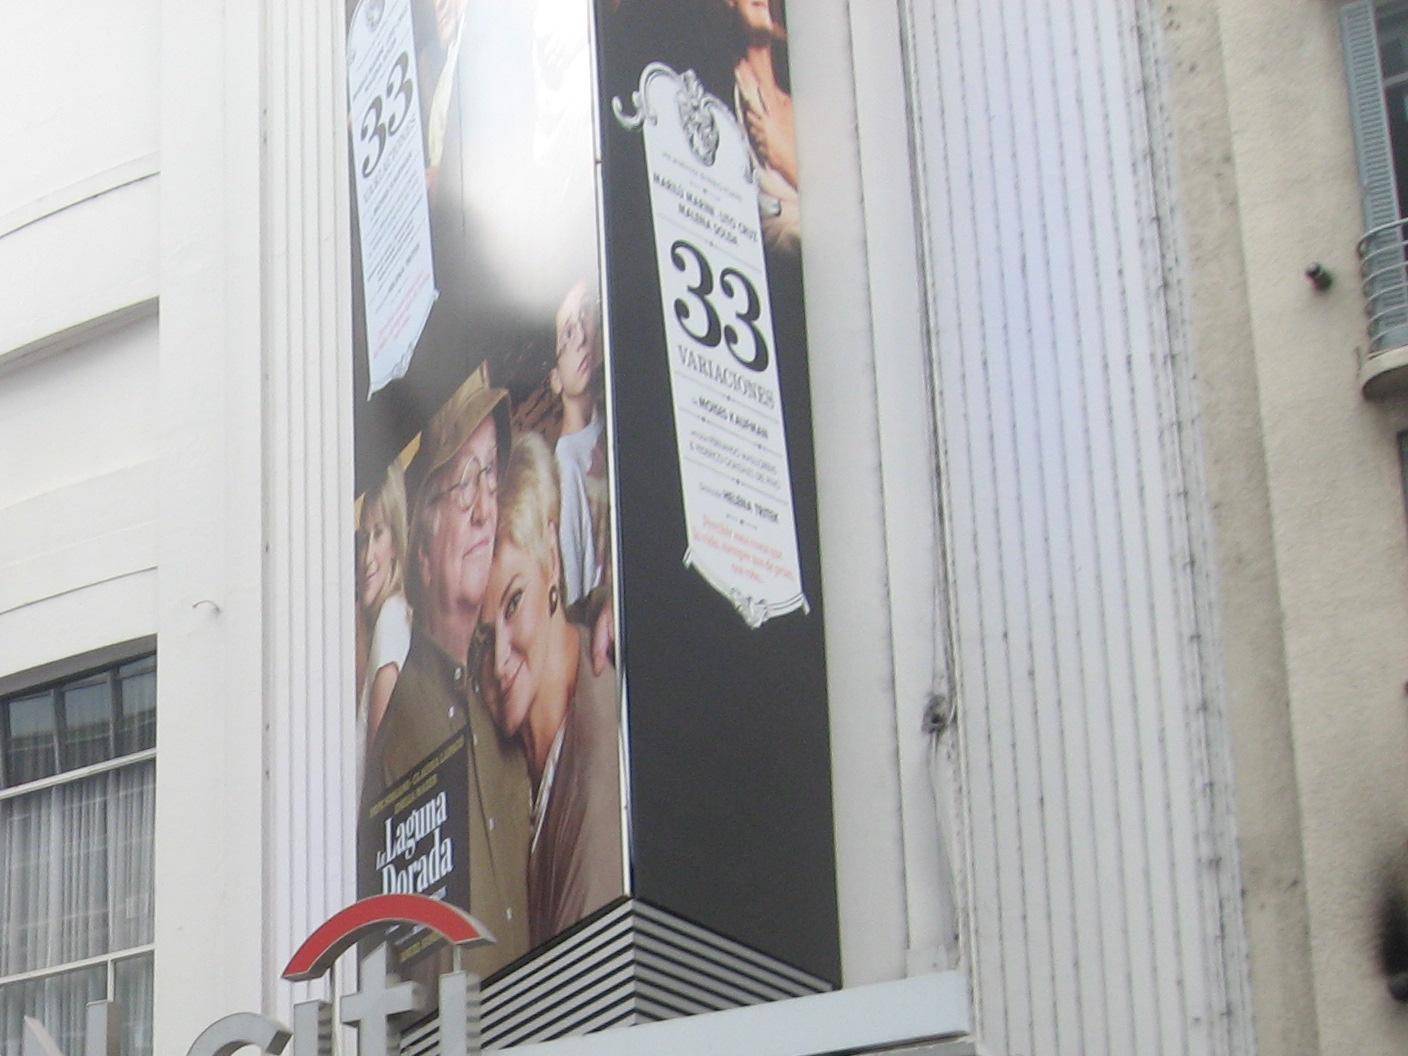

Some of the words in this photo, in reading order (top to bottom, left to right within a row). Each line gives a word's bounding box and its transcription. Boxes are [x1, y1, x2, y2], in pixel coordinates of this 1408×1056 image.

[359, 51, 413, 179] 33
[669, 239, 770, 373] 33
[382, 825, 454, 894] Dorada
[384, 791, 448, 862] Laguna
